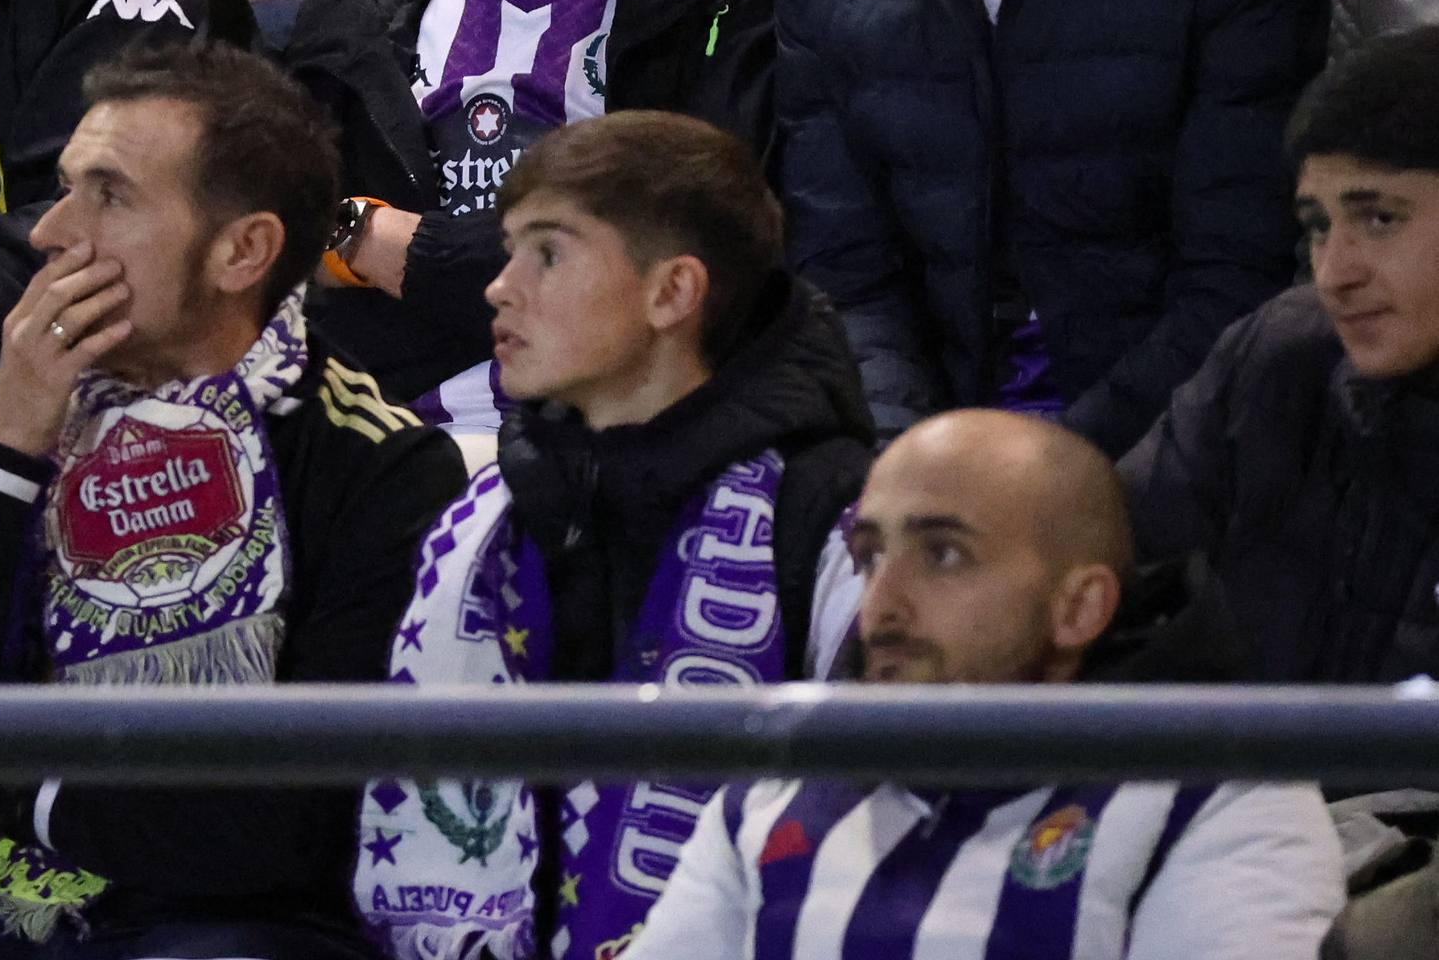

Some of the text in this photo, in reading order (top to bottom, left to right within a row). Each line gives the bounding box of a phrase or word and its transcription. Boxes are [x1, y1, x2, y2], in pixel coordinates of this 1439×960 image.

[79, 456, 211, 512] Estrella
[116, 600, 205, 637] QUALITY
[201, 385, 252, 430] BEER
[108, 498, 195, 536] Damm
